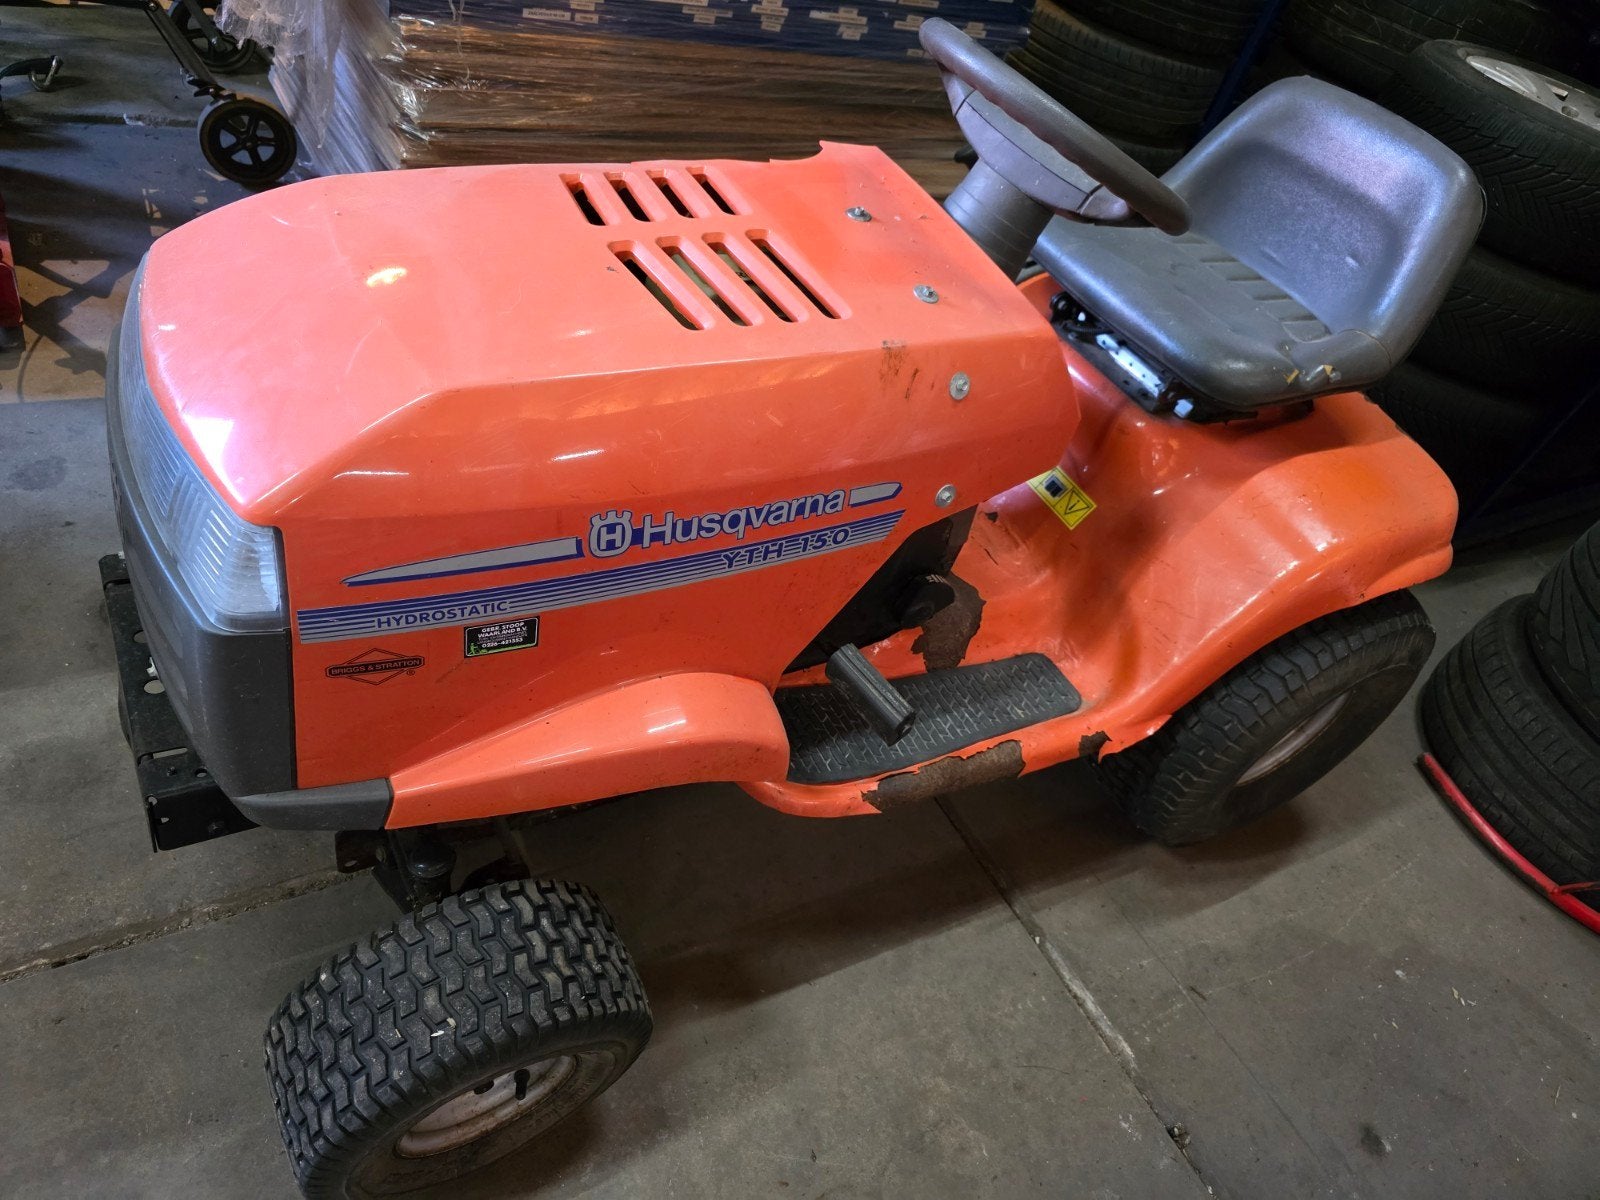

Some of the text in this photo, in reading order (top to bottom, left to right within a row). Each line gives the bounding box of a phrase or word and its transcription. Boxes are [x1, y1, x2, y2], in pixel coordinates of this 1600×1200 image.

[642, 489, 846, 549] Husqvarna
[723, 528, 850, 569] YTH 150
[377, 601, 508, 629] HYDROSTATIC
[502, 621, 525, 630] STOOP
[478, 628, 516, 638] WAARLAND
[331, 665, 366, 675] BRIGGS
[375, 659, 420, 670] STRATTON
